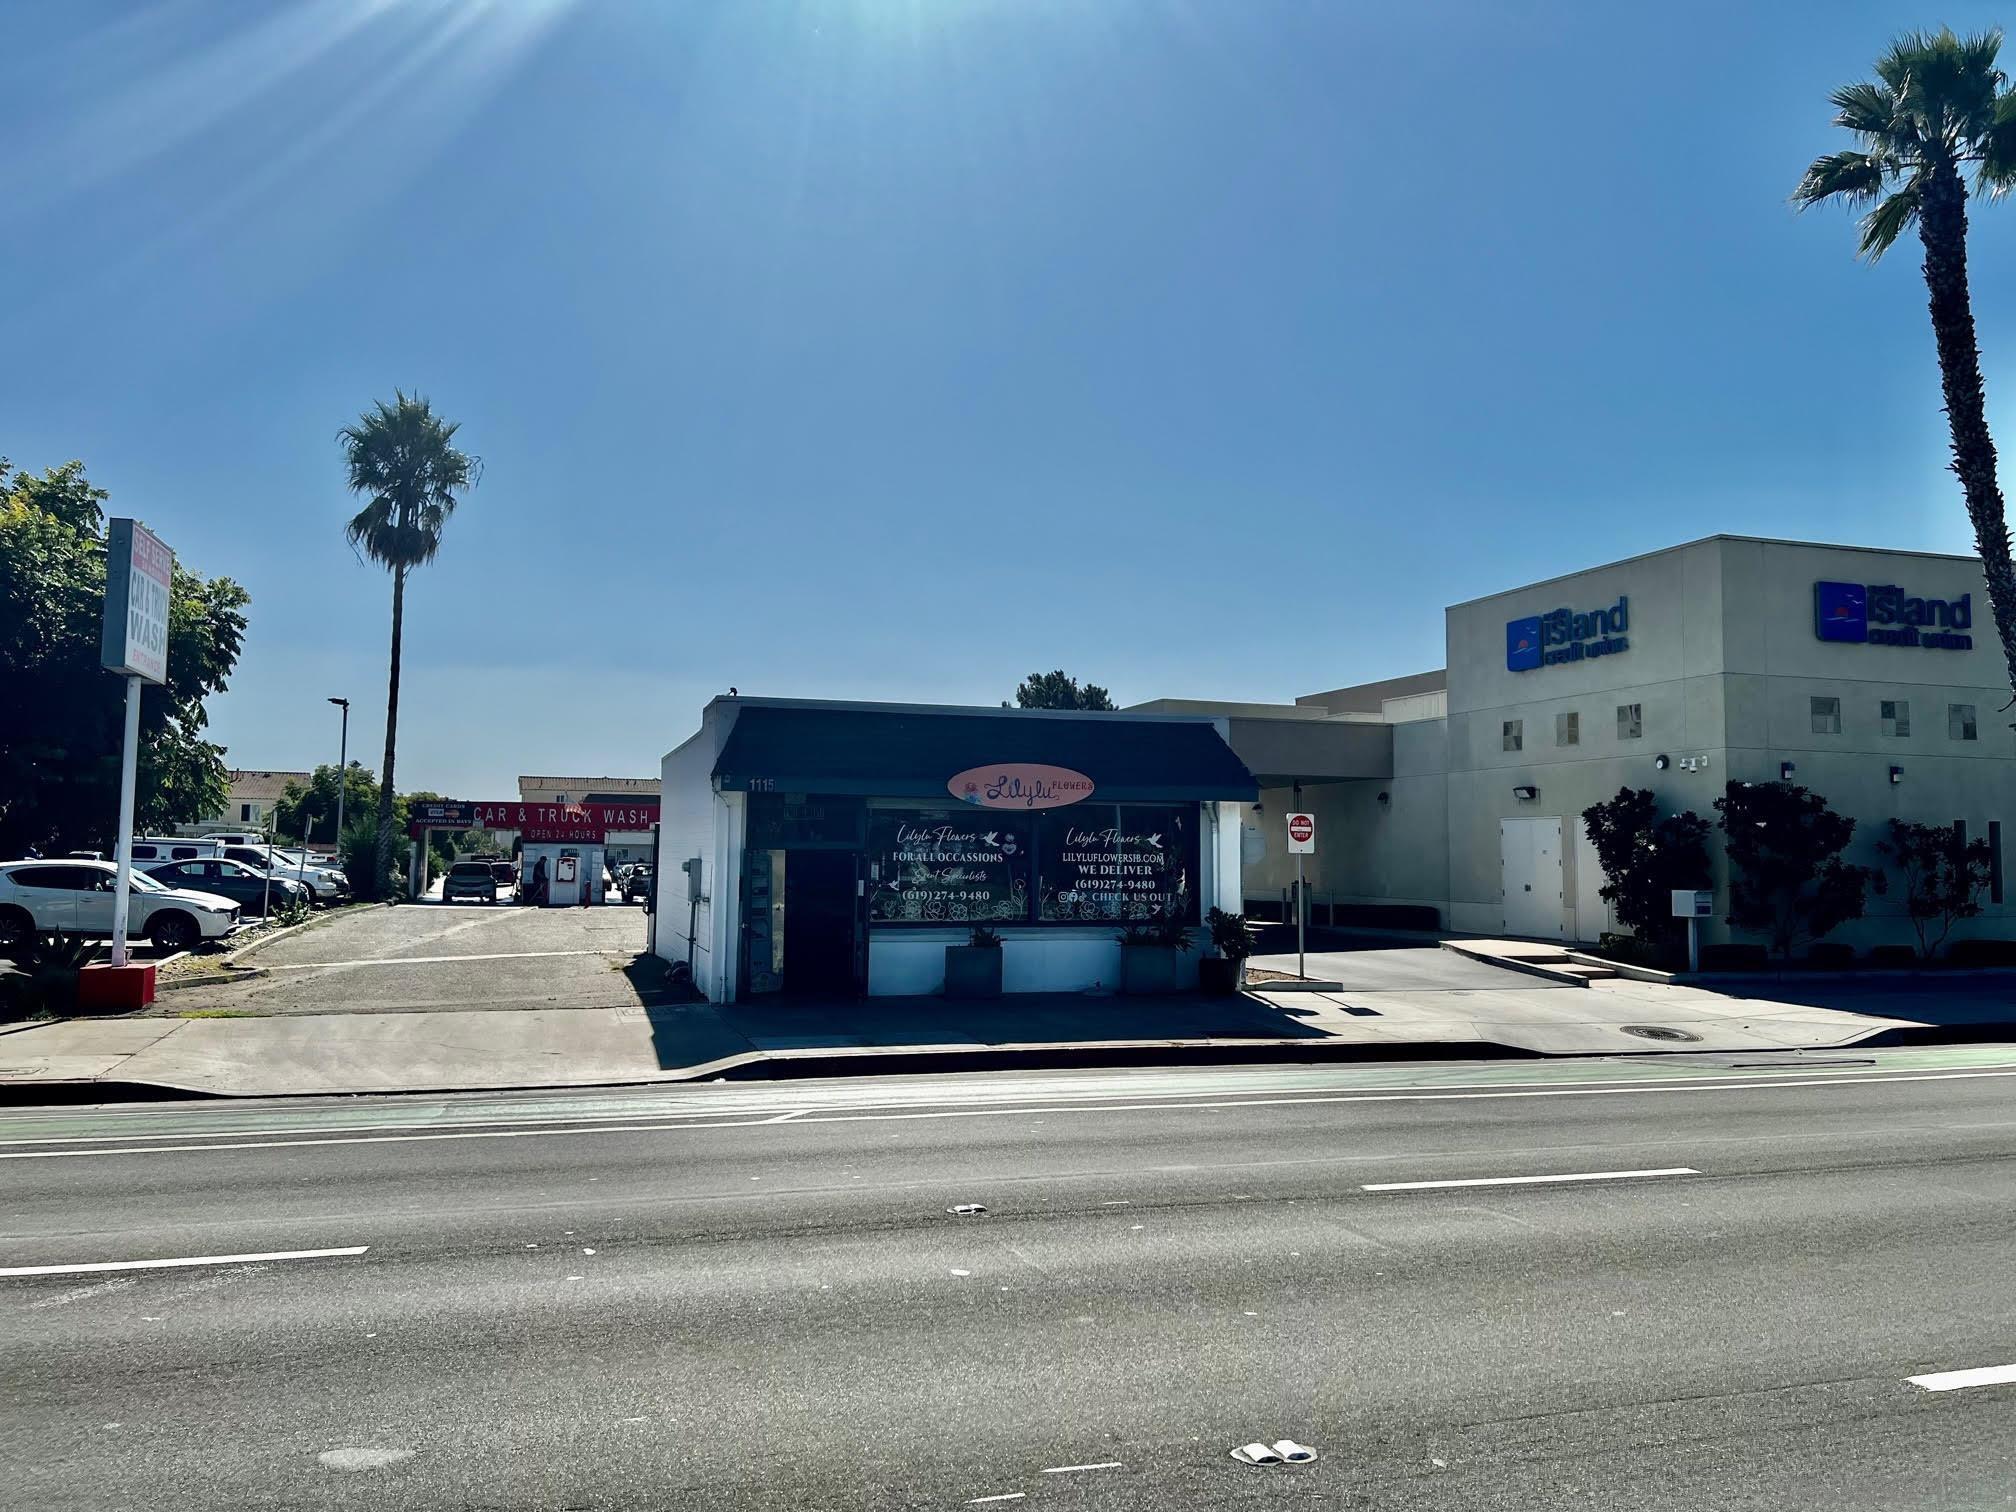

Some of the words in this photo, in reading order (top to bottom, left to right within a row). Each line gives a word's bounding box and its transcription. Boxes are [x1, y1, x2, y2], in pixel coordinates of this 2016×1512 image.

[134, 530, 150, 561] SELF
[131, 571, 145, 611] CAR
[130, 610, 167, 656] WASH
[132, 648, 161, 675] ENTRANCE
[984, 775, 1059, 807] Lilylu
[1052, 780, 1094, 791] FLOWERS
[473, 807, 506, 821] CAR
[518, 808, 527, 822] &
[538, 808, 592, 823] TRUCK
[604, 809, 648, 824] WASH
[531, 830, 551, 839] OPEN
[569, 830, 596, 839] HOURS
[897, 824, 932, 845] Lilylu
[932, 825, 978, 846] Flowers
[1066, 827, 1099, 848] Lilylu
[1100, 828, 1141, 848] Flowers
[893, 852, 914, 862] FOR
[914, 852, 936, 862] ALL
[937, 852, 1003, 863] OCCASSIONS
[1062, 853, 1164, 863] LILYLUFLOWERSIB.COM
[1078, 865, 1097, 875] WE
[1100, 865, 1152, 875] DELIVER
[1075, 879, 1155, 890] (619)274-9480
[902, 890, 990, 901] (619)274-9480
[1092, 892, 1129, 901] CHECK
[1133, 892, 1147, 901] US
[1149, 892, 1172, 901] OUT
